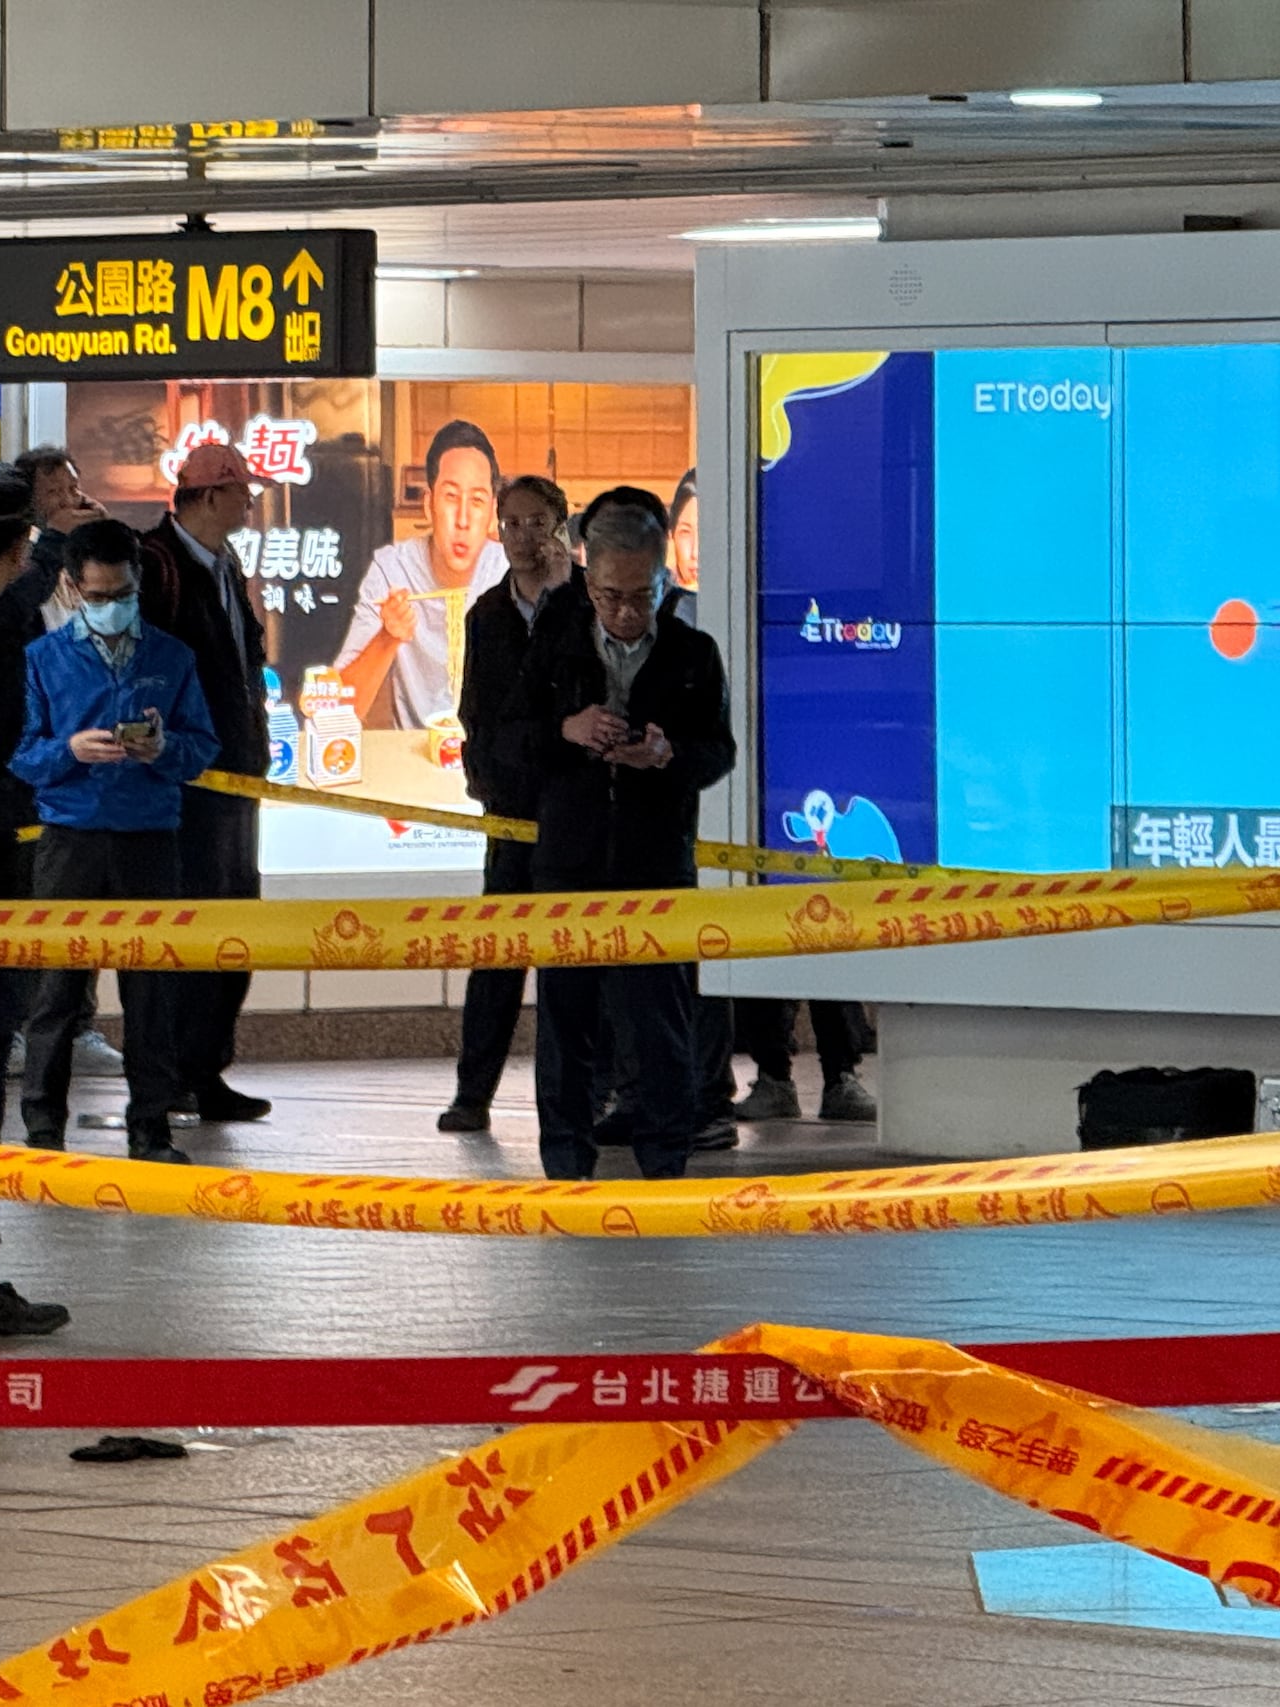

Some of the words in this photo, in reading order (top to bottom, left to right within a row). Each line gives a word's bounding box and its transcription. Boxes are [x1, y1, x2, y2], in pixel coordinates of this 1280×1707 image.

[54, 258, 177, 318] 公園路
[187, 265, 275, 341] M8
[5, 328, 129, 362] Gongyuan
[135, 325, 177, 354] Rd.
[975, 379, 1113, 420] ETtoday
[801, 616, 901, 649] ETtoday
